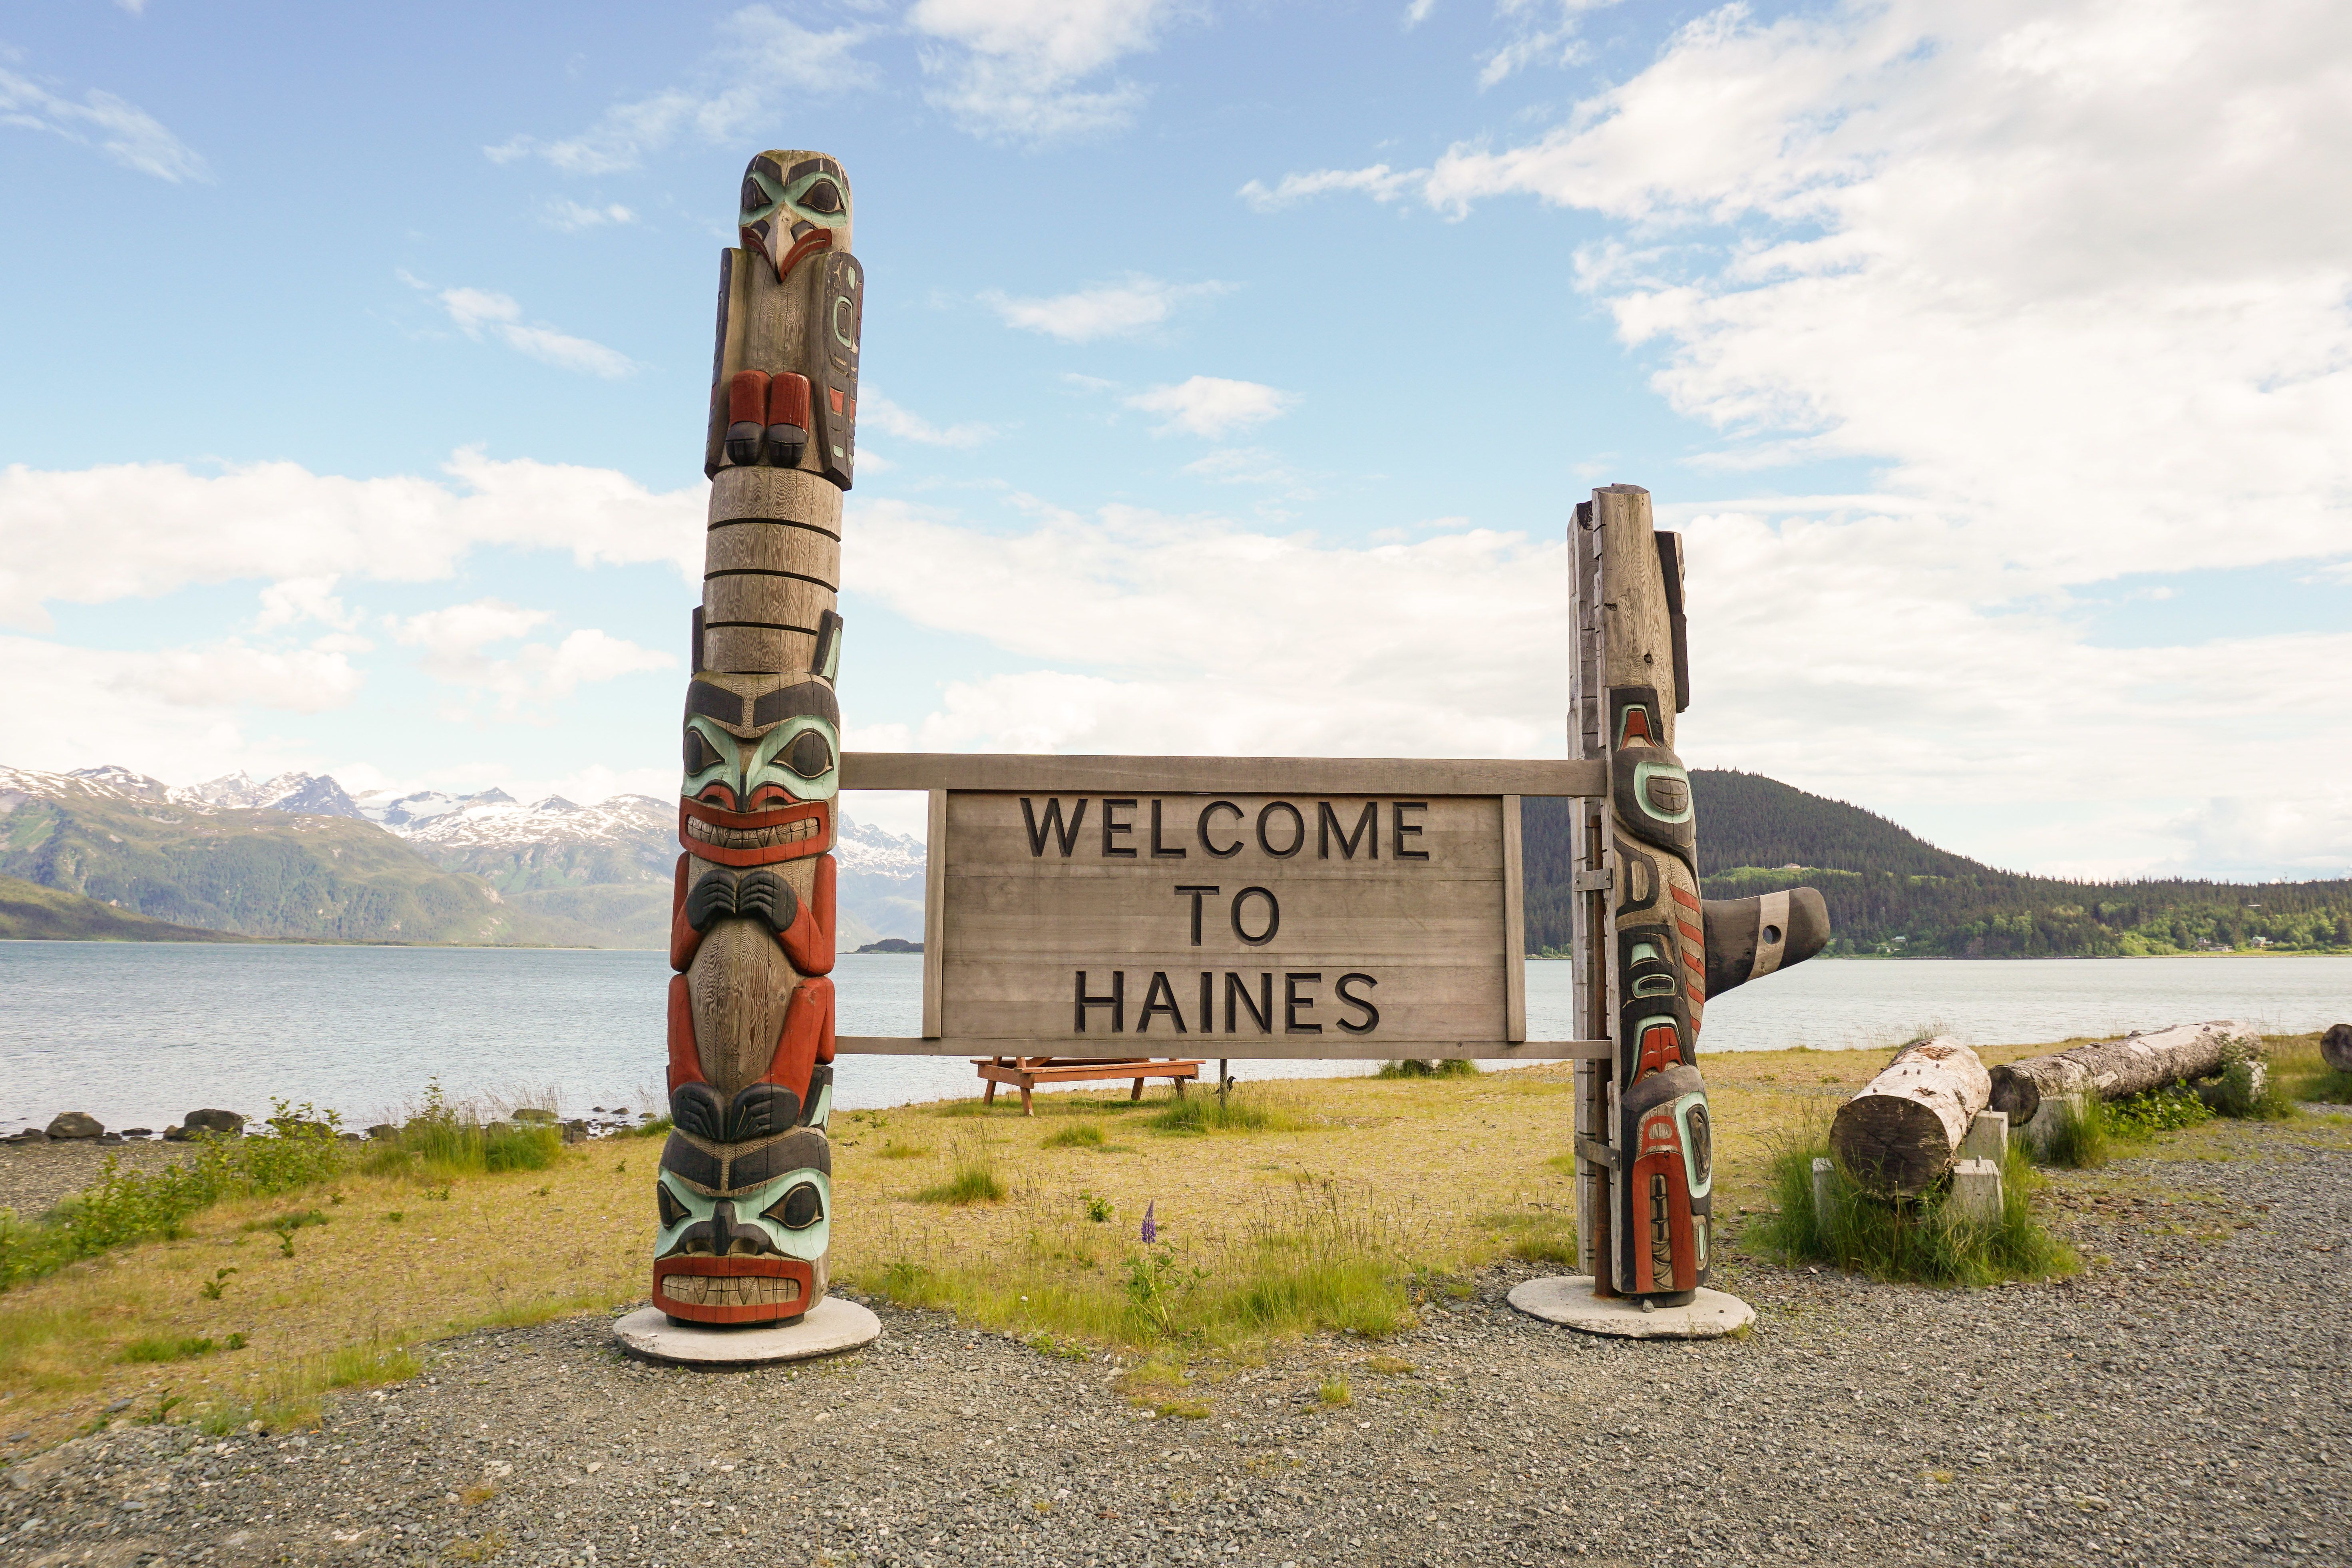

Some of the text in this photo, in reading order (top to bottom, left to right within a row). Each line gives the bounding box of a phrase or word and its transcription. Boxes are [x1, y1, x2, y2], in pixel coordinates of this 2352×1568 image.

[1019, 797, 1429, 861] WELCOME
[1174, 885, 1280, 947] TO
[1074, 971, 1379, 1035] HAINES
